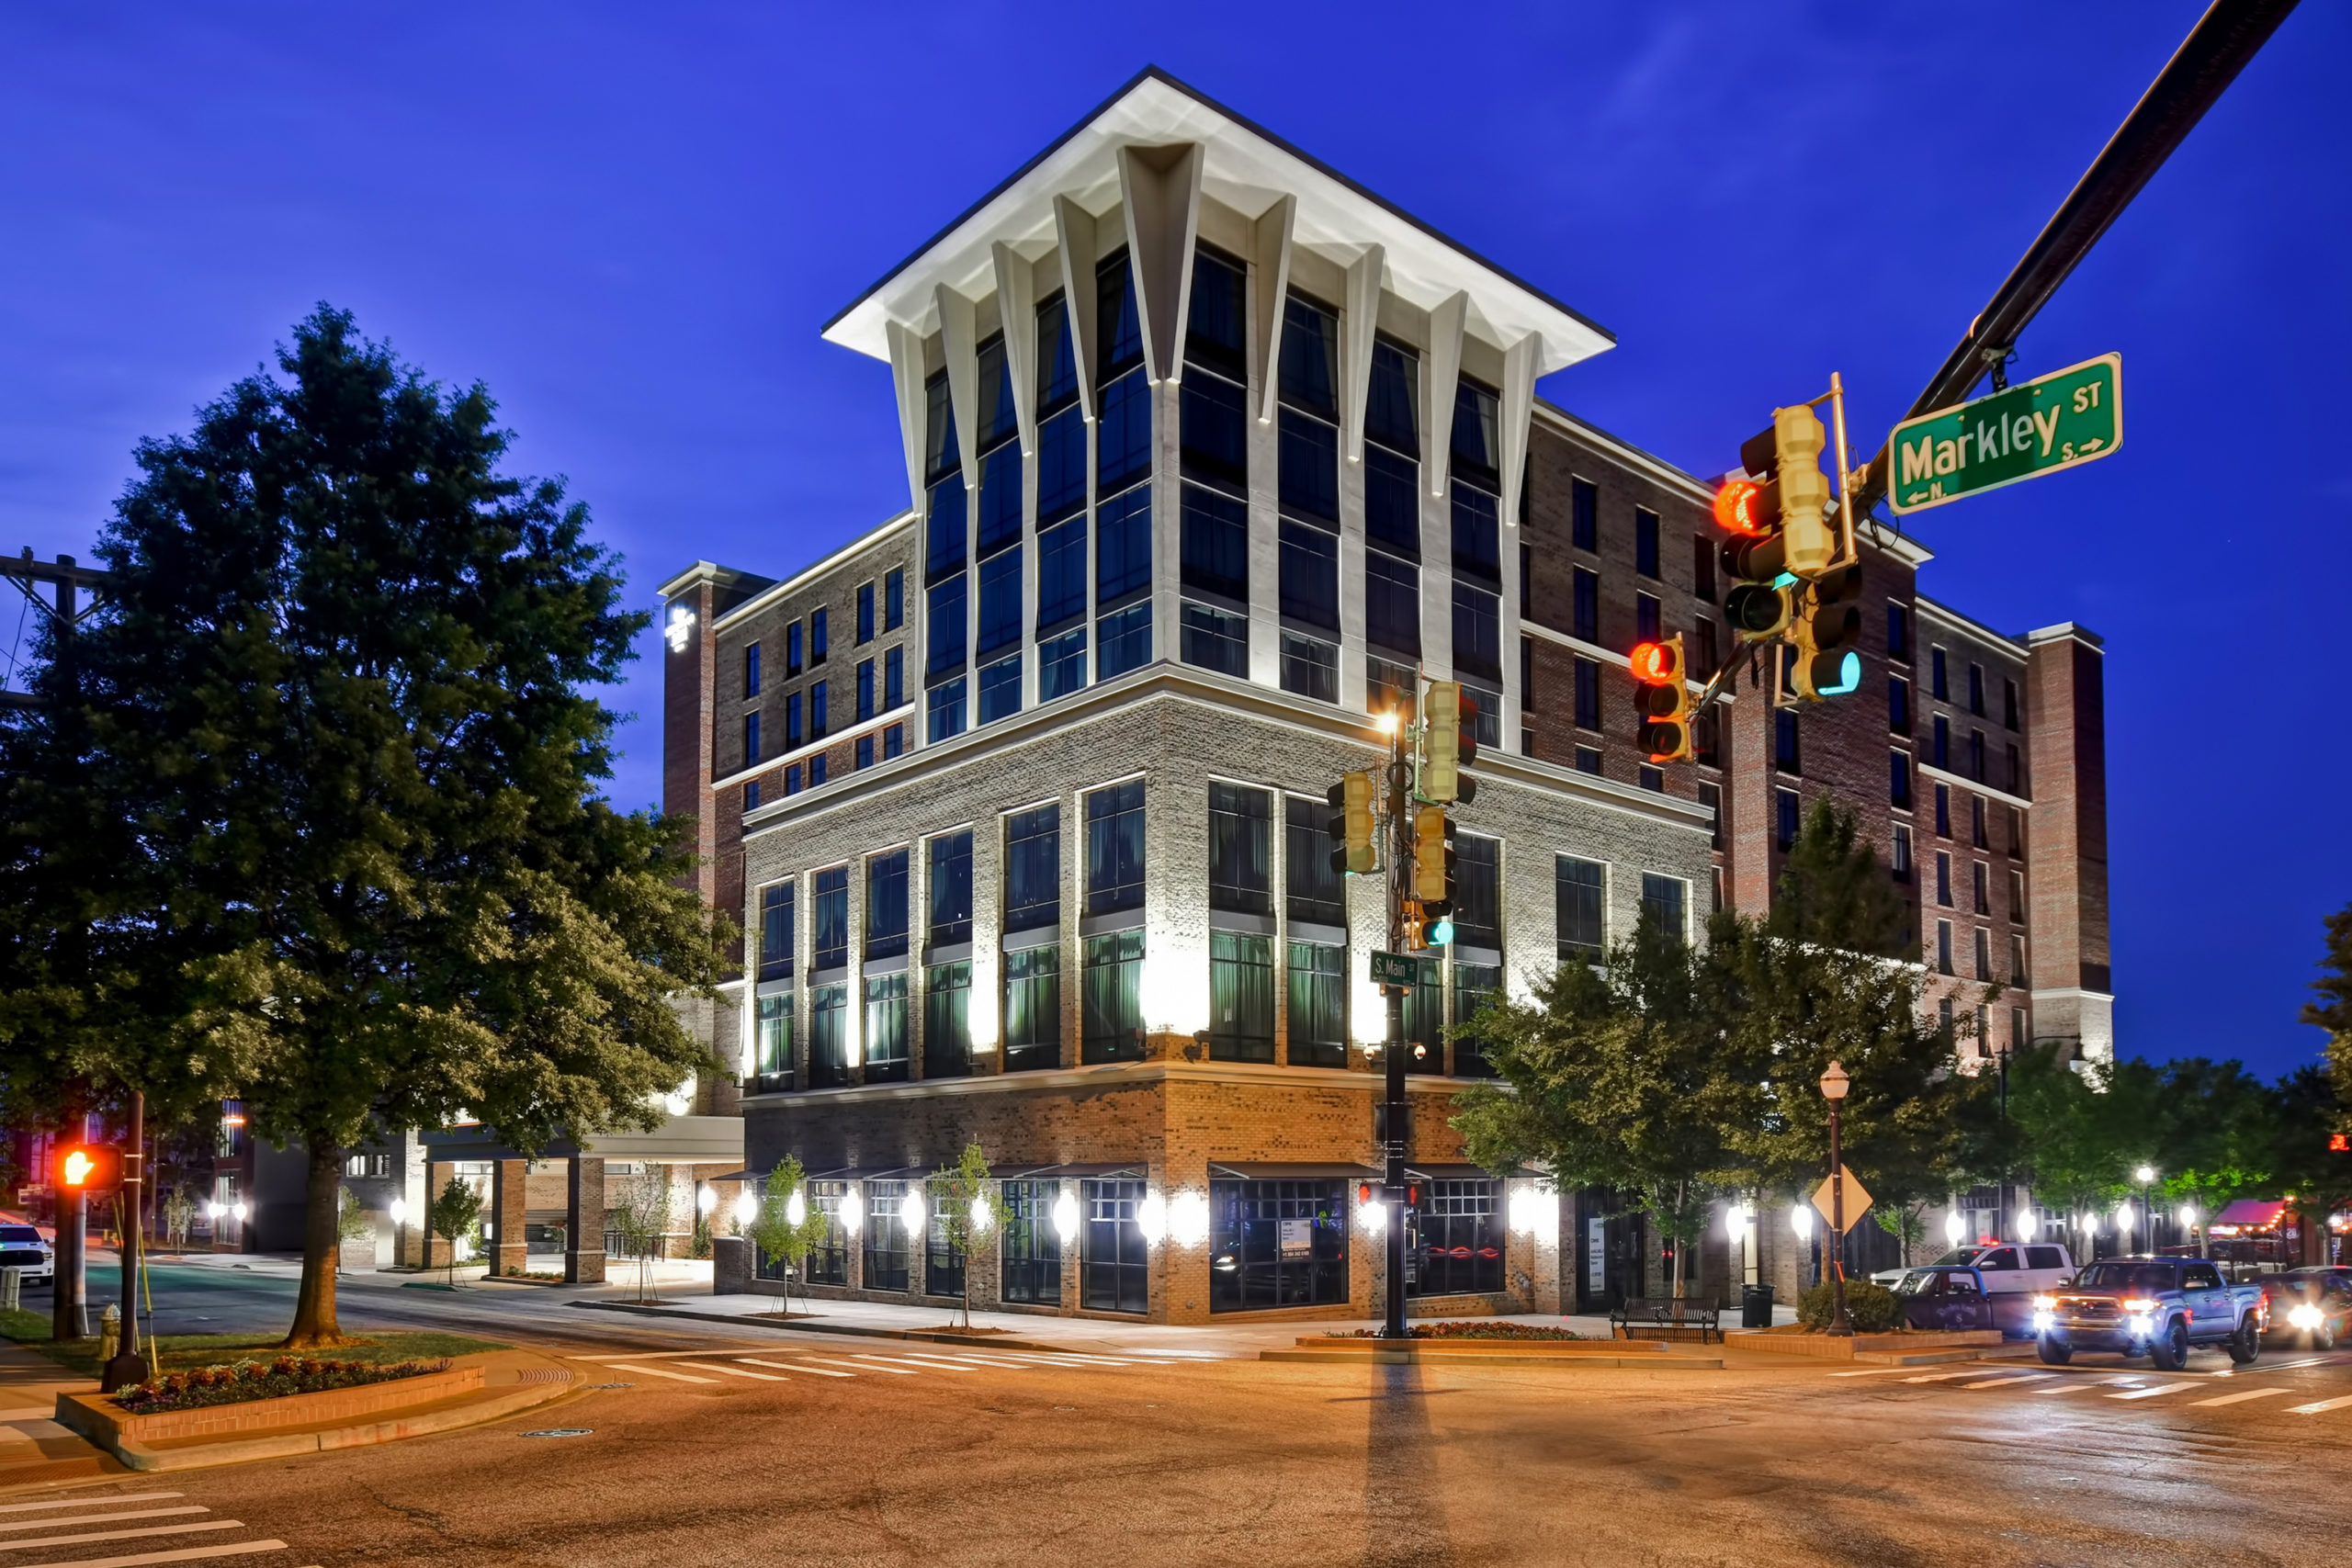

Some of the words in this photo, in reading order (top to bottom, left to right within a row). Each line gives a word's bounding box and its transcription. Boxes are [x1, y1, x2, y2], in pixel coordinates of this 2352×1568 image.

[1901, 404, 2061, 486] Markley
[2072, 380, 2103, 413] ST
[2061, 441, 2078, 462] S.
[1929, 480, 1948, 500] N.
[1374, 956, 1385, 975] S.
[1385, 958, 1406, 978] Main
